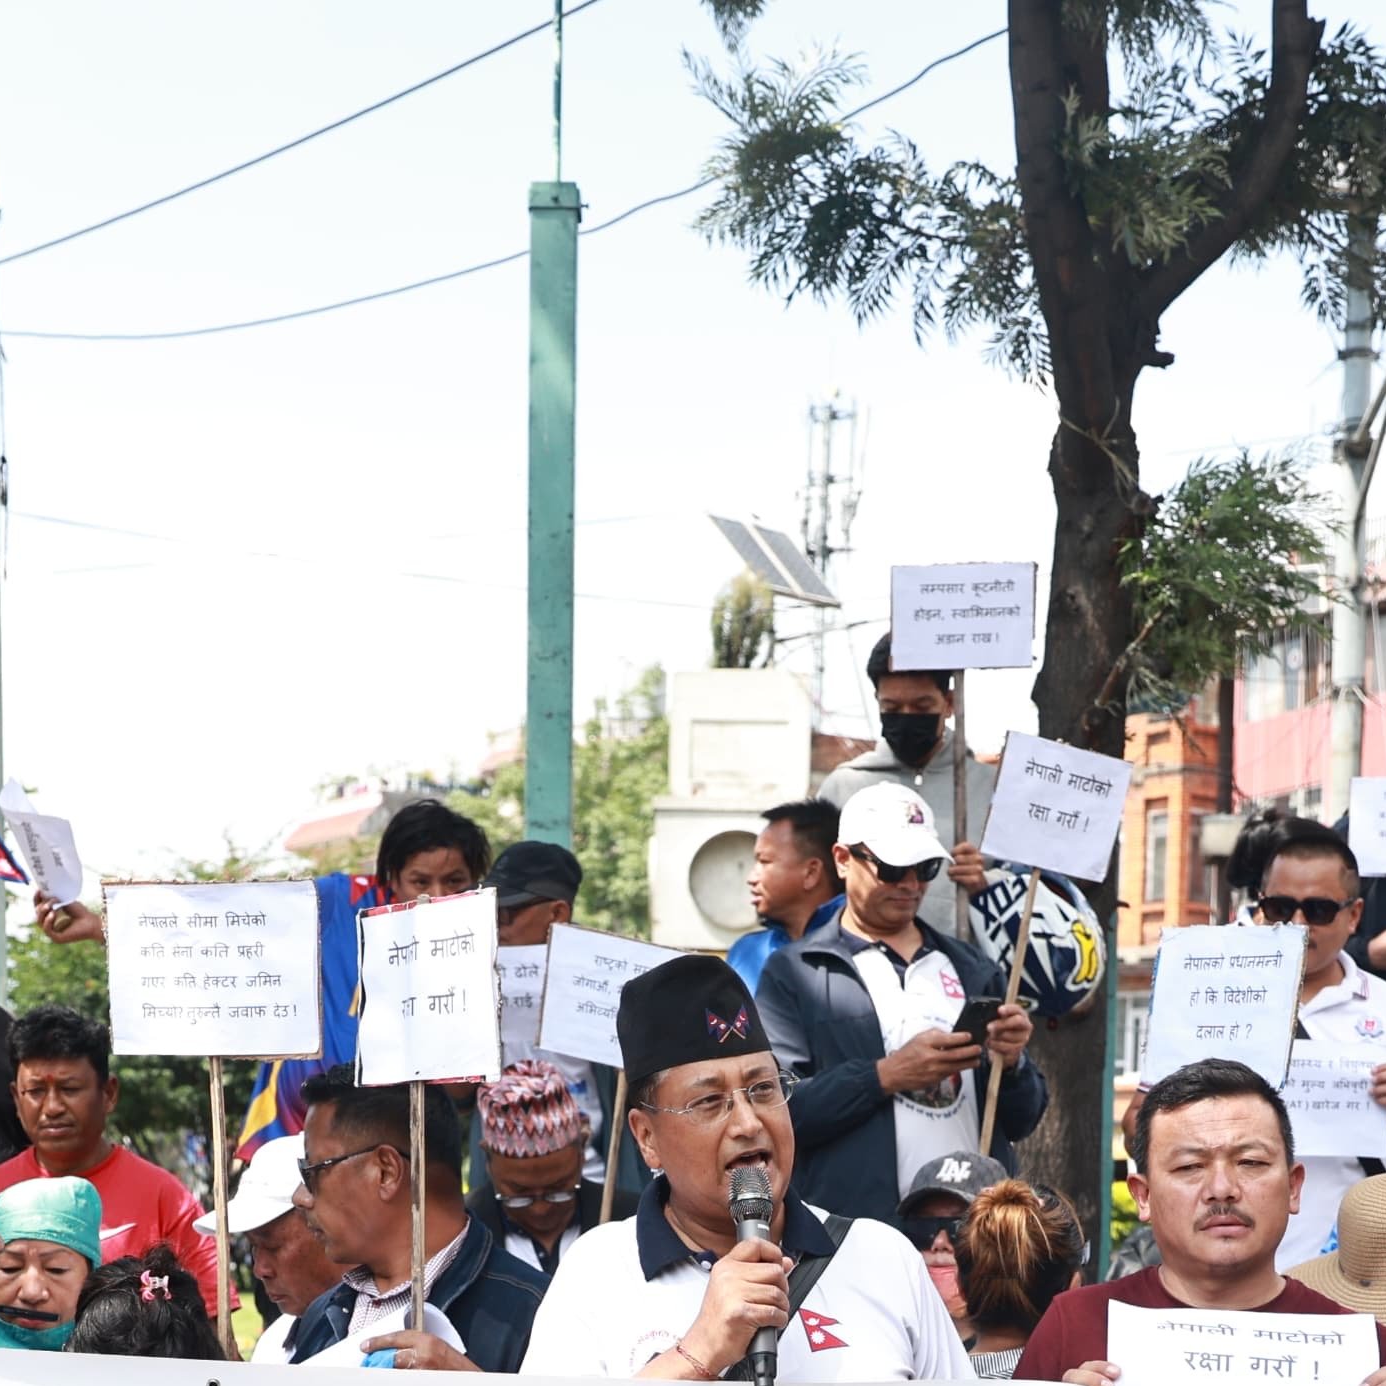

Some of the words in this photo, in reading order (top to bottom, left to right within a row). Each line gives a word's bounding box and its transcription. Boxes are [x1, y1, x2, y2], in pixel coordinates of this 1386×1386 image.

[1024, 758, 1064, 785] नेपाली
[1067, 773, 1113, 799] माटोको
[1028, 801, 1051, 824] रक्षा
[1084, 815, 1091, 833] !
[138, 911, 179, 929] नेपालले
[186, 912, 219, 929] सीमा
[225, 910, 267, 928] मिचेको
[139, 942, 165, 959] कति
[172, 944, 193, 959] सेना
[200, 941, 229, 959] कति
[237, 941, 265, 960] प्रहरी
[1183, 952, 1225, 972] नेपालको
[1229, 949, 1284, 970] प्रधानमन्त्री
[141, 976, 166, 989] गएर
[174, 972, 197, 988] कति
[203, 973, 239, 991] हेक्टर
[245, 971, 282, 988] जमिन
[1189, 986, 1202, 1008] हो
[1204, 986, 1218, 1006] कि
[1223, 985, 1268, 1005] विदेशीको
[1196, 1024, 1225, 1041] दलाल
[1228, 1023, 1240, 1042] हो
[1245, 1023, 1253, 1040] ?
[1156, 1321, 1237, 1336] नेपाली
[1253, 1329, 1346, 1346] माटोको
[1183, 1350, 1234, 1373] रक्षा
[1313, 1360, 1320, 1381] !
